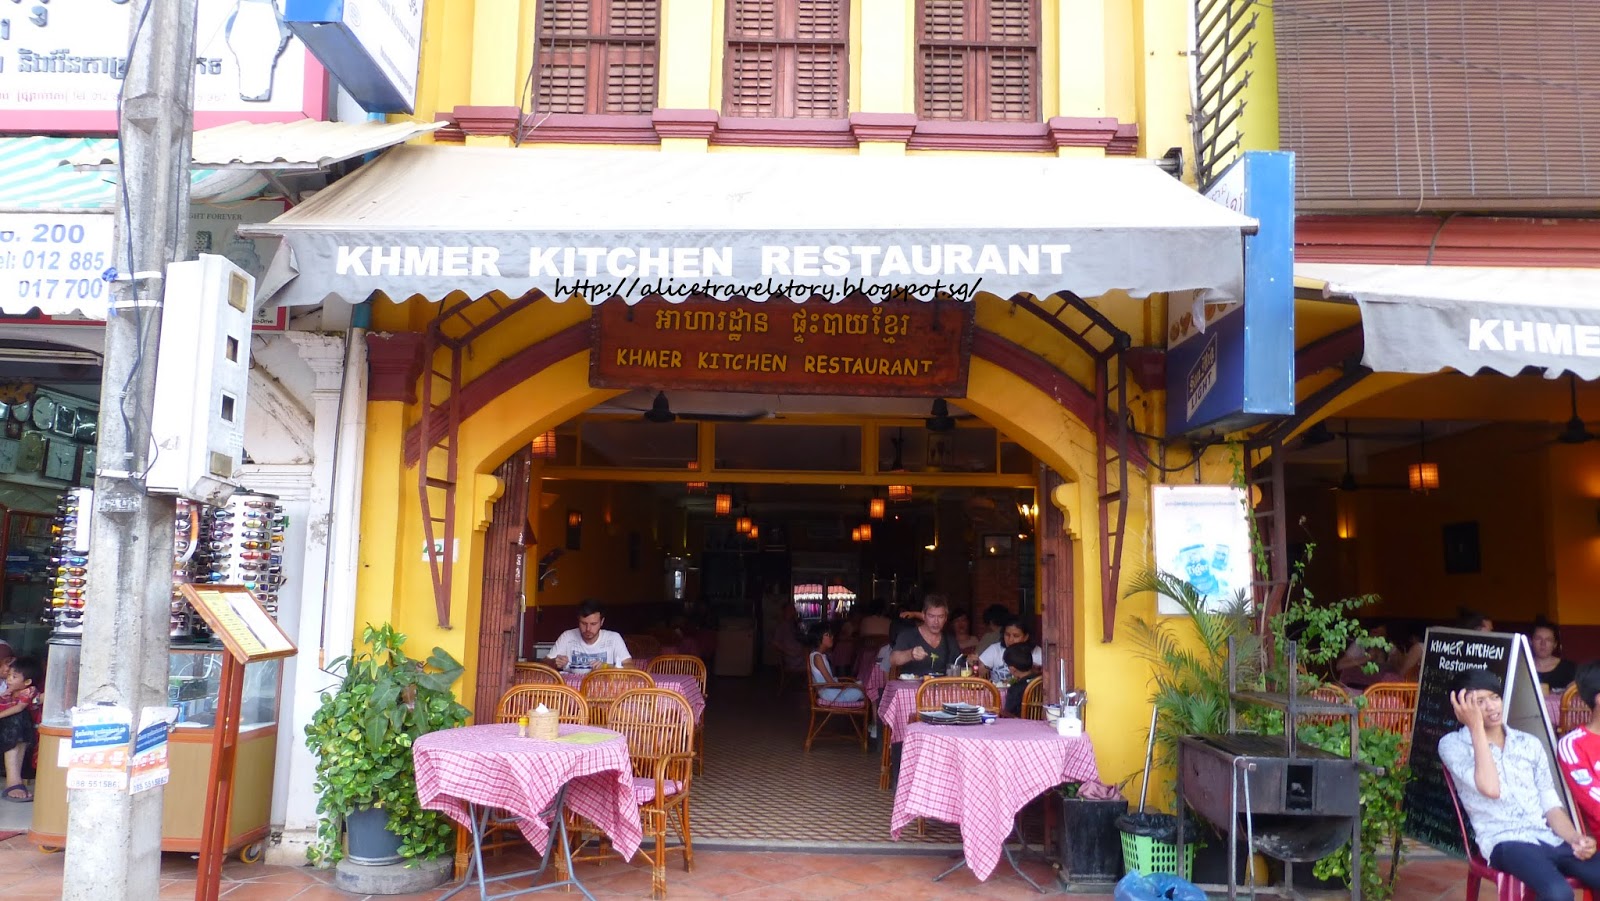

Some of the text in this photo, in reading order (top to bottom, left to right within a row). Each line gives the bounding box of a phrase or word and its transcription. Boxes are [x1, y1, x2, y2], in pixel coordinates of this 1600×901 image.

[0, 223, 85, 244] o. 200
[23, 250, 60, 270] 012
[69, 251, 104, 271] 885
[335, 244, 1072, 278] KHMER KITCHEN RESTAURANT
[19, 278, 103, 299] 017 700
[1468, 318, 1600, 357] KHME
[616, 348, 934, 377] KHMER KITCHEN RESTAURANT
[1430, 640, 1505, 660] KHMER KITCHEN
